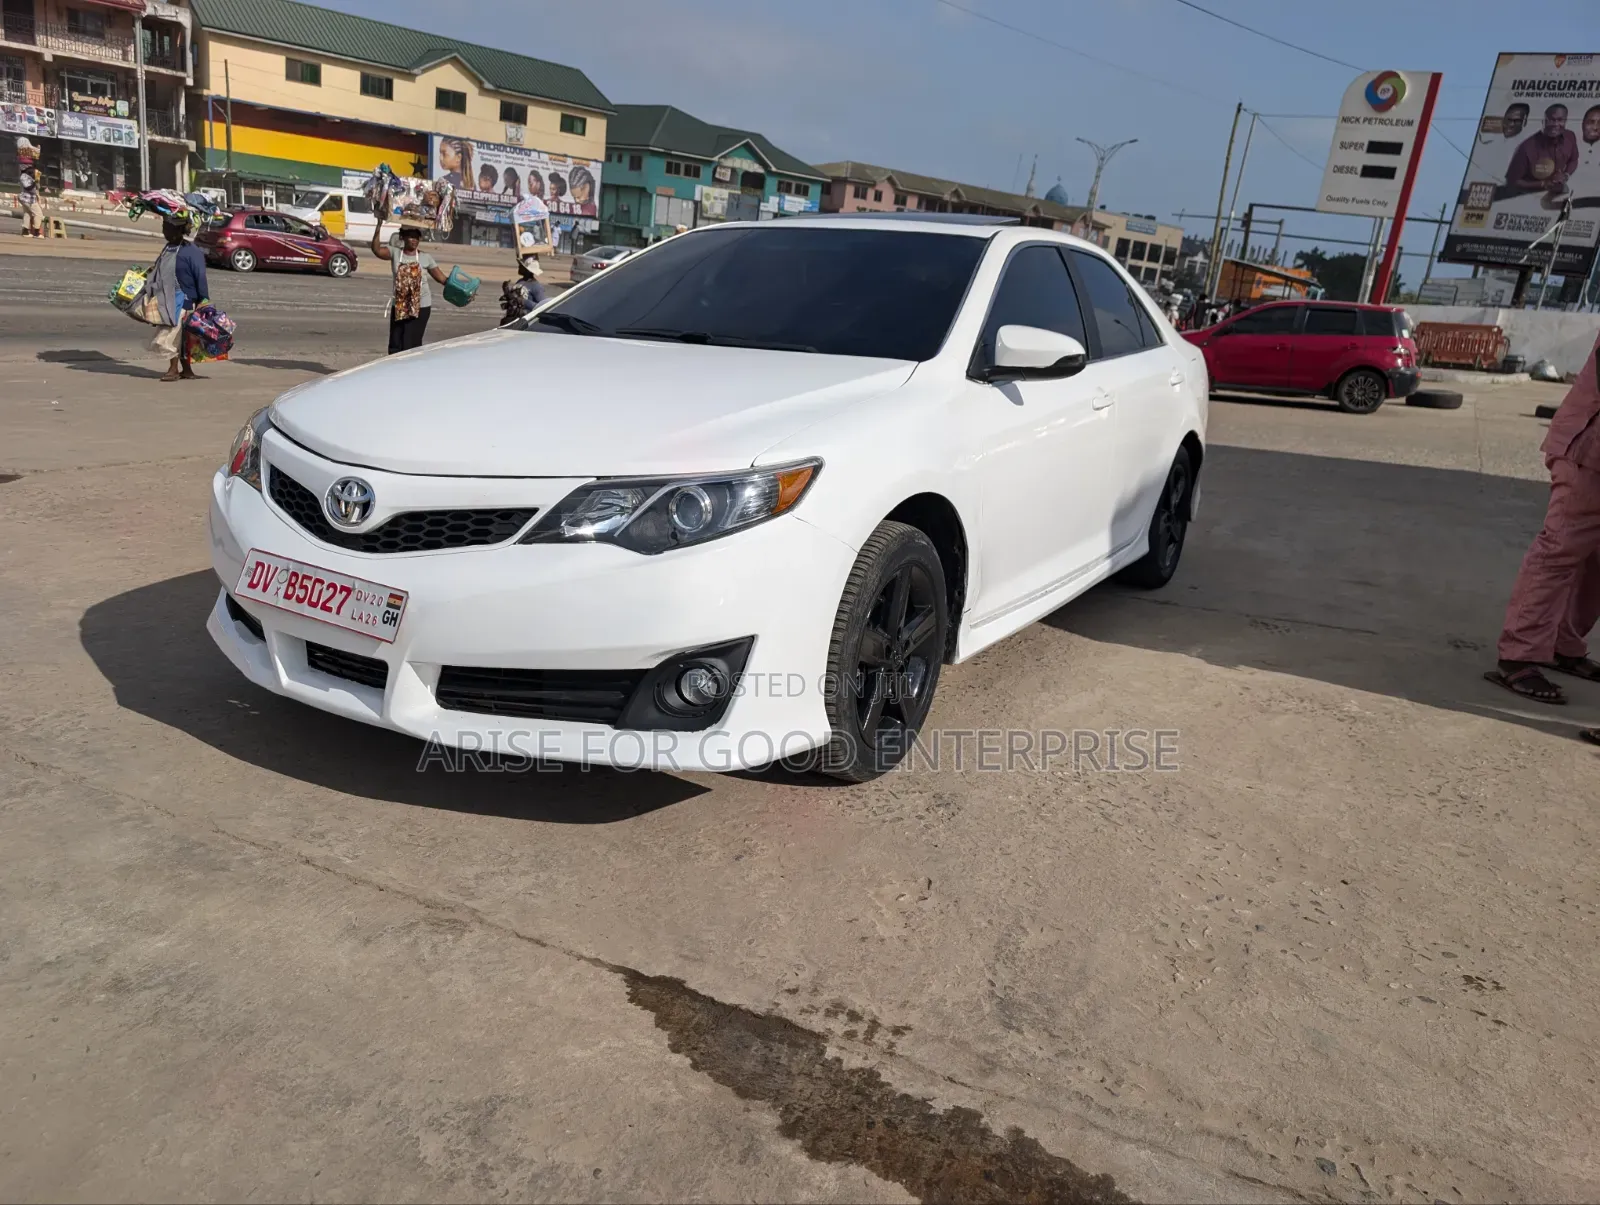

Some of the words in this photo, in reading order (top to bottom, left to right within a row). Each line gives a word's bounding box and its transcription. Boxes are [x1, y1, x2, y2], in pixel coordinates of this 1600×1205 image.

[1341, 116, 1361, 124] NICK
[1362, 116, 1414, 127] PETROLEUM
[1339, 141, 1365, 151] SUPER
[1333, 165, 1359, 175] DIESEL
[500, 194, 518, 204] SALON
[1326, 194, 1350, 204] Quality
[1351, 196, 1371, 205] Fuels
[1372, 199, 1389, 208] Only
[559, 202, 570, 213] 64
[572, 204, 582, 214] 18
[1464, 211, 1484, 221] 2PM
[248, 561, 279, 593] DV
[283, 570, 353, 616] B5027
[355, 589, 384, 607] DV20
[351, 608, 378, 627] LA26
[382, 610, 399, 627] GH
